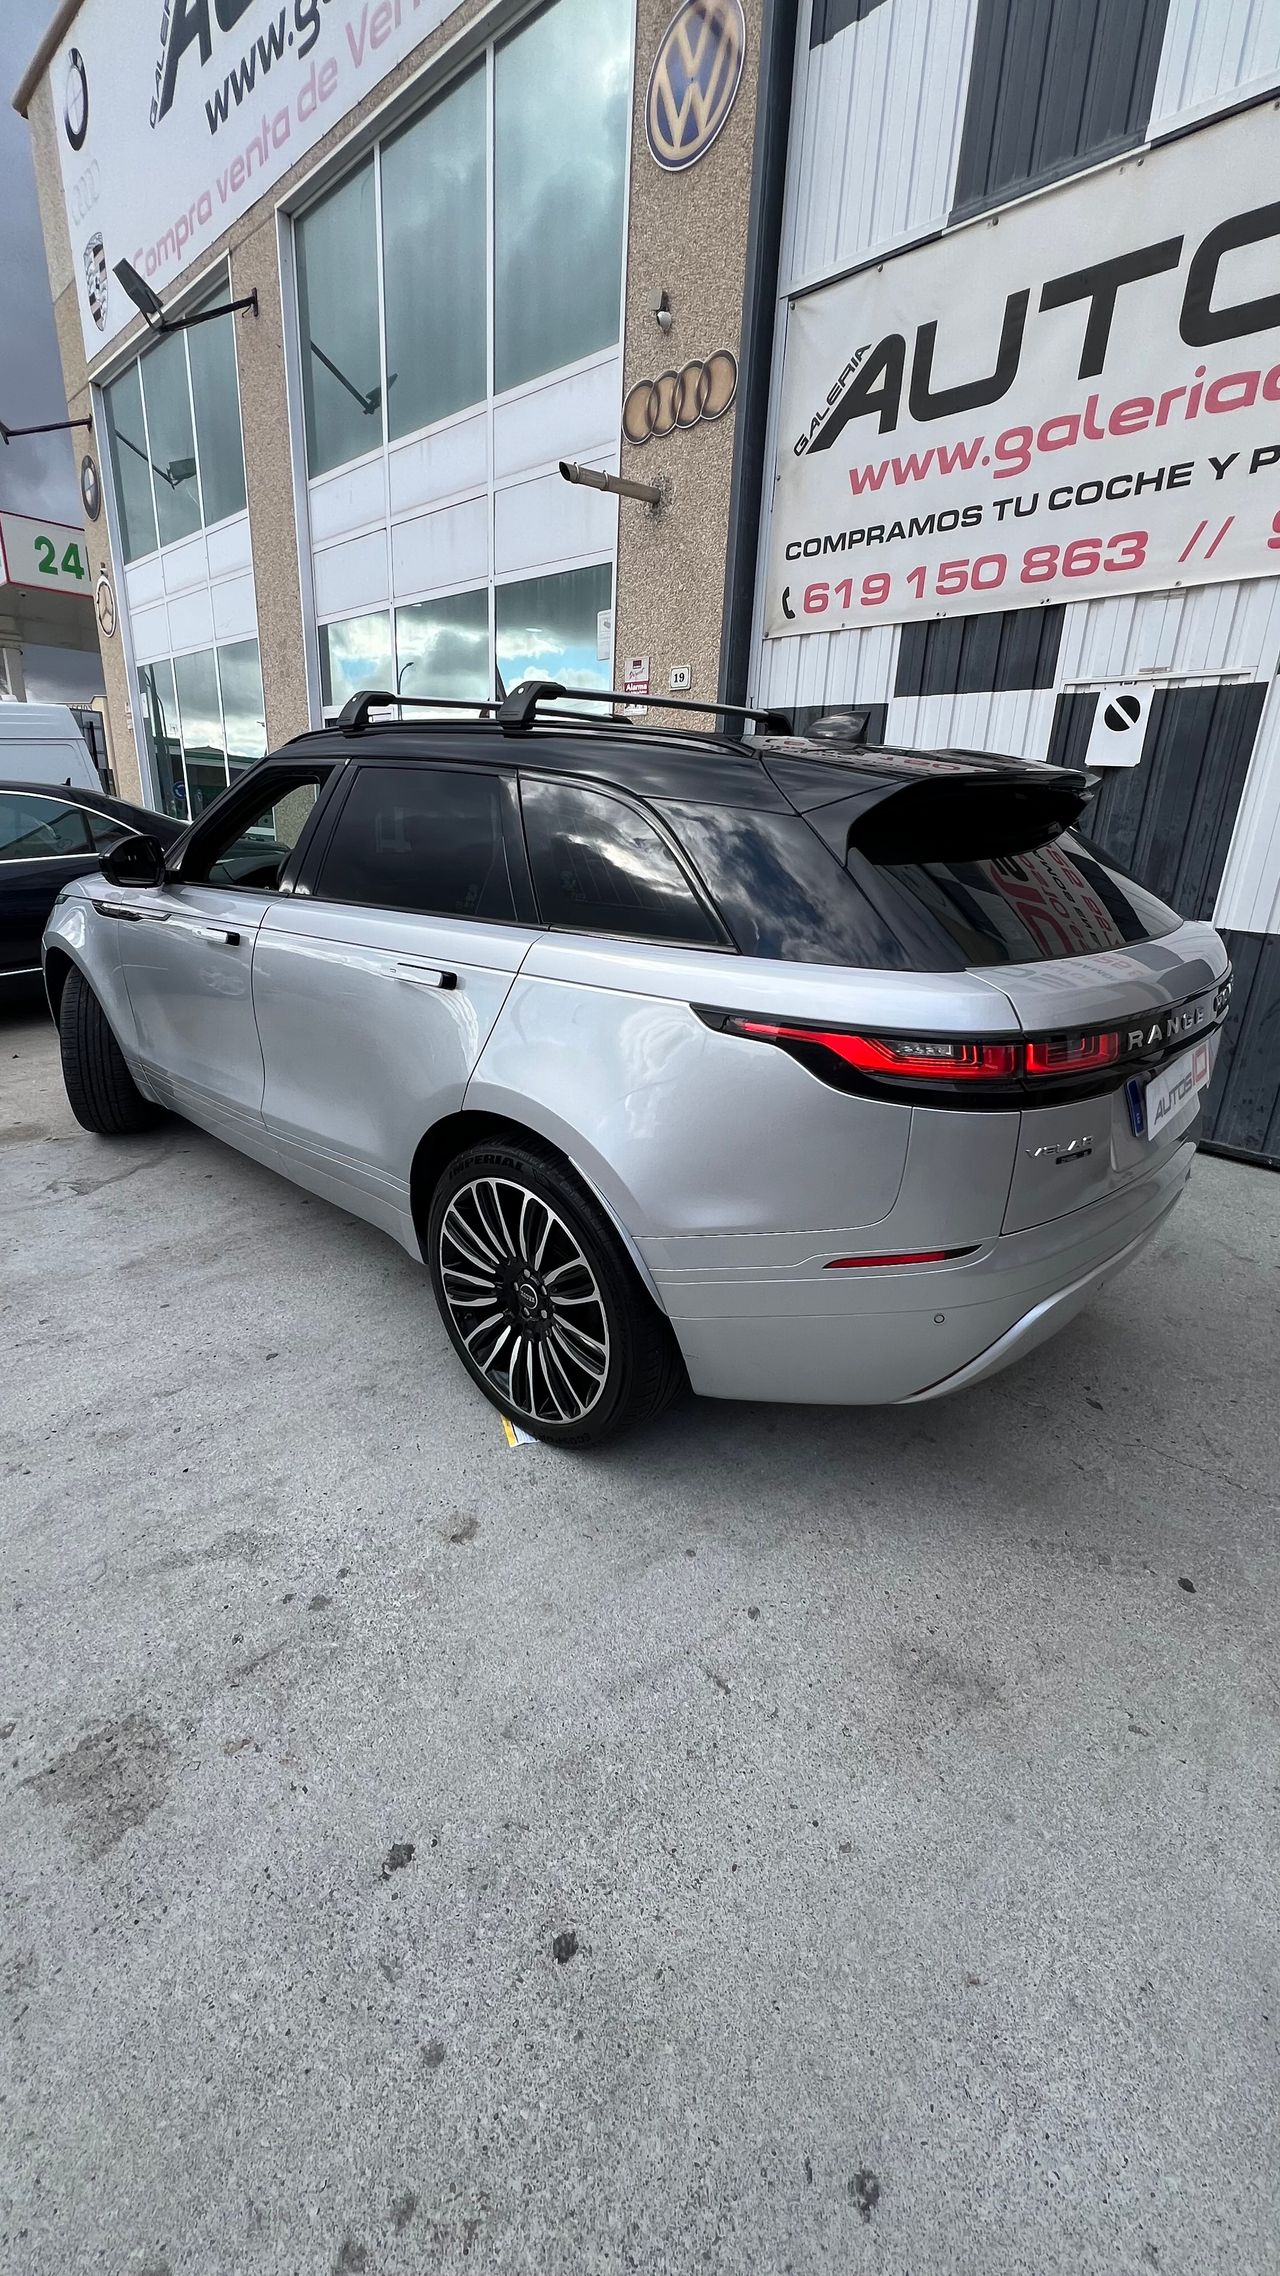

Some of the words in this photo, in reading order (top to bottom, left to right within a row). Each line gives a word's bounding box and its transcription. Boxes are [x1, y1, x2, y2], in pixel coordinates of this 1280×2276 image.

[204, 0, 332, 135] www.g
[216, 105, 291, 204] venta
[297, 56, 338, 122] de
[793, 343, 873, 457] GALERIA
[785, 504, 983, 561] COMPRAMOS
[992, 493, 1040, 522] TU
[1048, 461, 1195, 511] COCHE
[1208, 451, 1241, 480] Y
[34, 535, 85, 579] 24
[803, 572, 892, 614] 619
[906, 553, 1008, 599] 150
[1020, 530, 1149, 583] 863
[673, 672, 685, 683] 19
[1128, 1006, 1205, 1051] RANGE
